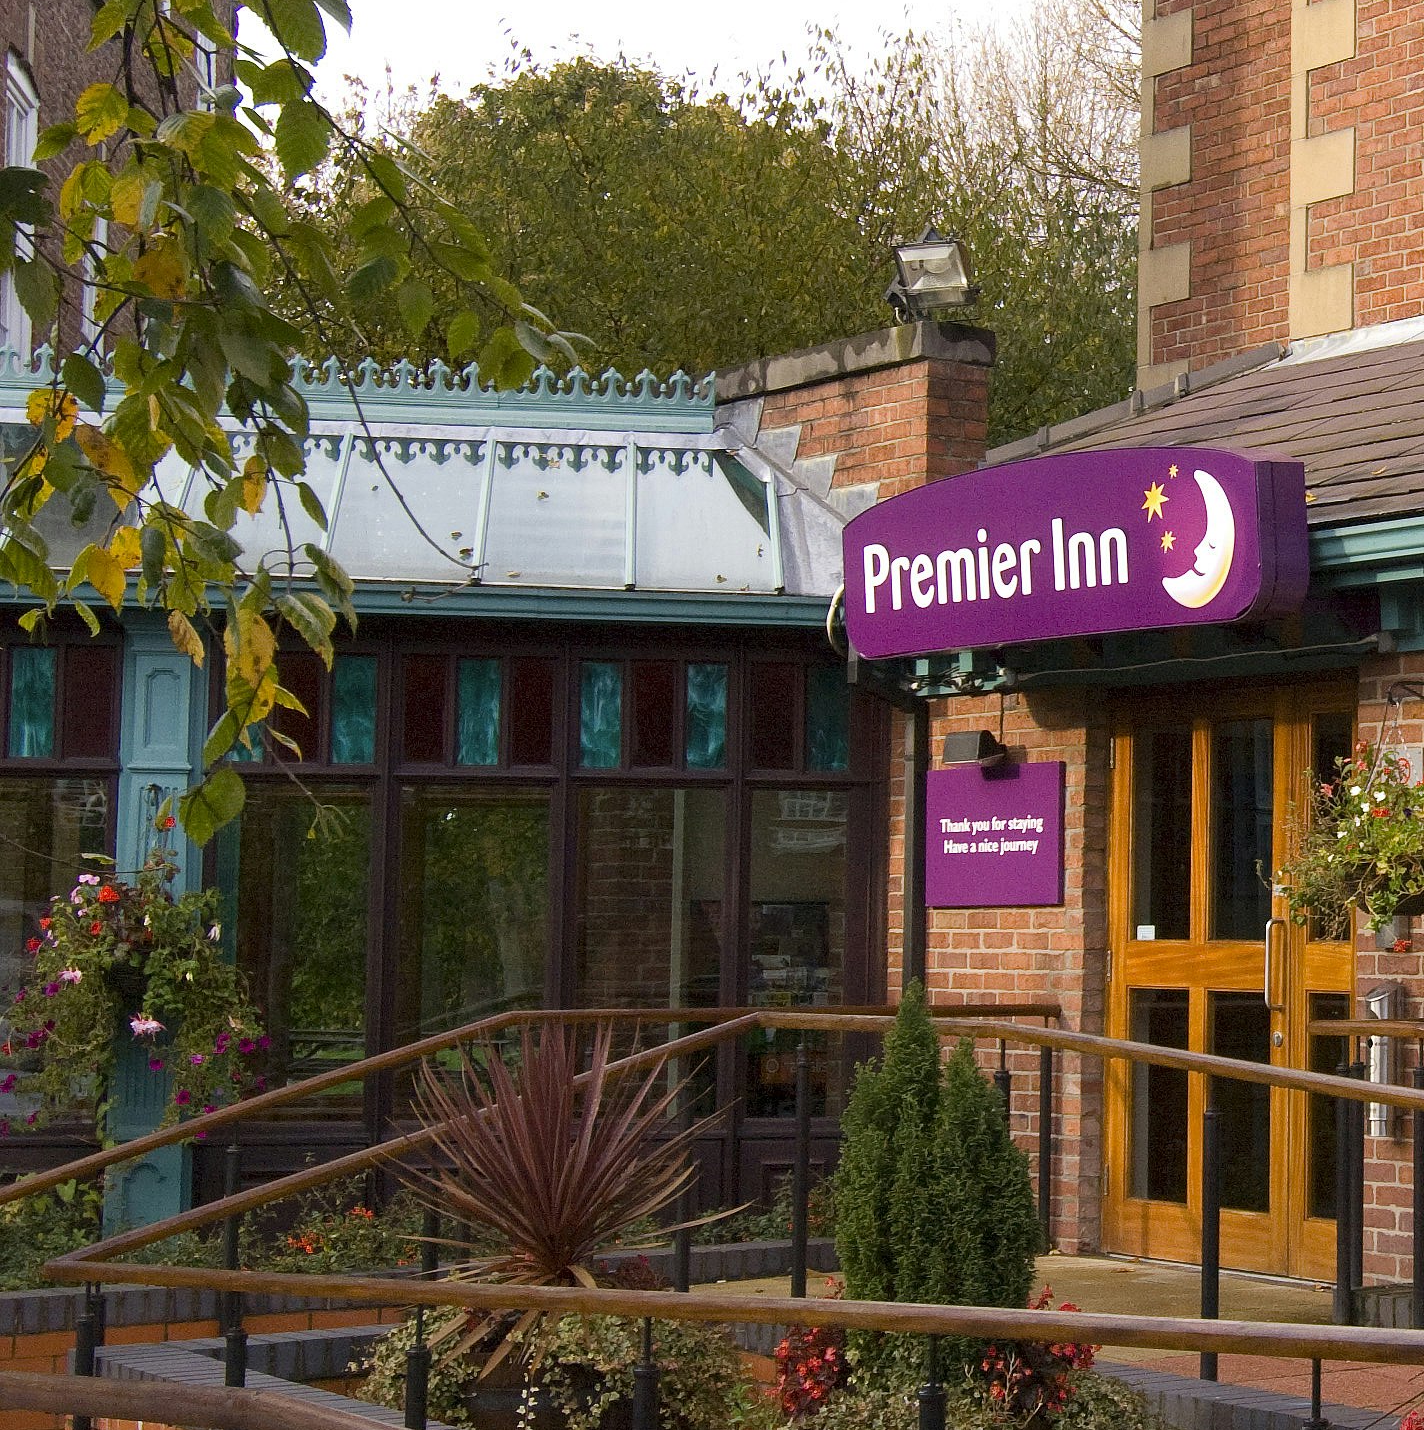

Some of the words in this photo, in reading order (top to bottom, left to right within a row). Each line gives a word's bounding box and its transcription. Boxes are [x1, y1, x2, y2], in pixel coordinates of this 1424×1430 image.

[863, 528, 1041, 613] Premier
[1052, 517, 1129, 591] Inn
[940, 818, 970, 833] Thank
[972, 820, 990, 836] you
[991, 815, 1007, 831] for
[1007, 814, 1044, 833] staying
[944, 840, 969, 854] Have
[969, 842, 977, 853] a
[978, 838, 999, 853] nice
[999, 837, 1039, 855] journey
